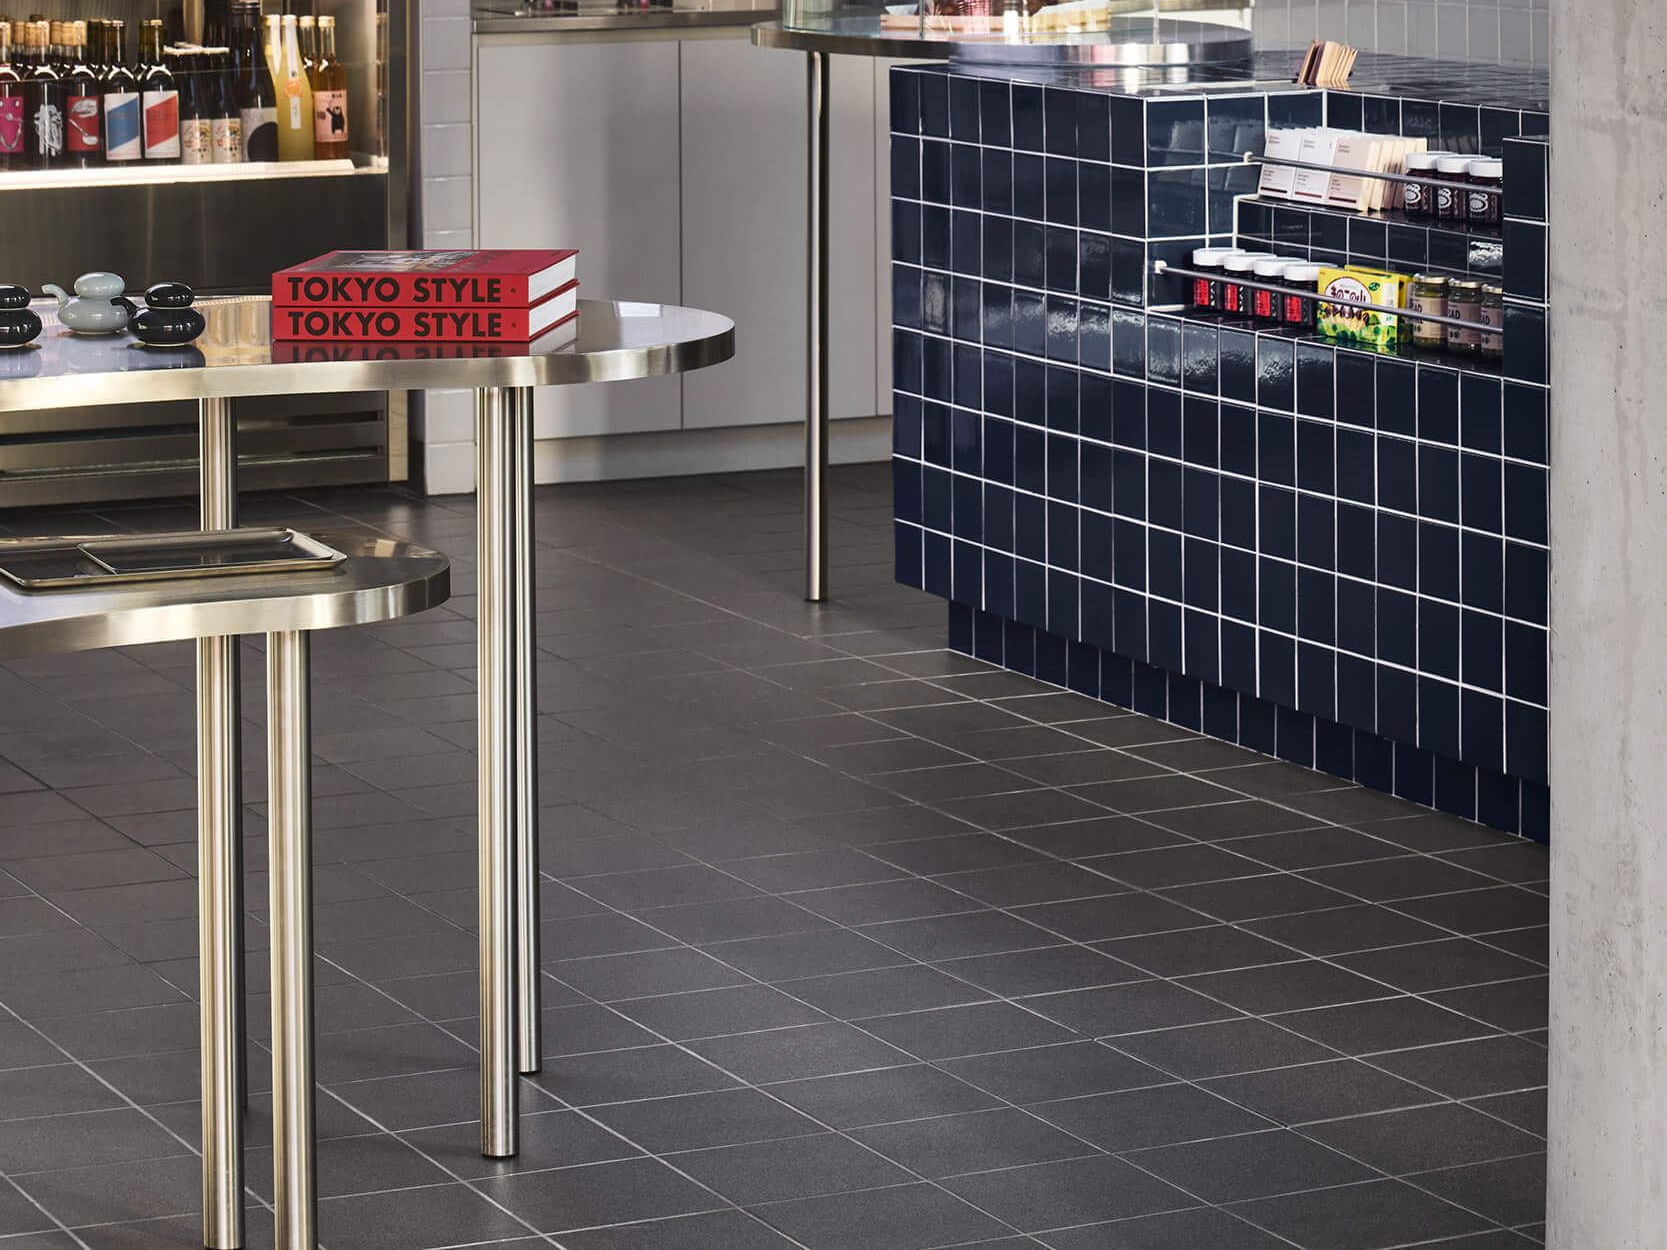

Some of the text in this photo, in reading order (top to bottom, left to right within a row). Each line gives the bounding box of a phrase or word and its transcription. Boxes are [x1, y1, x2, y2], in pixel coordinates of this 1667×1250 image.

[287, 276, 502, 303] TOKYO STYLE
[287, 310, 502, 337] TOKYO STYLE
